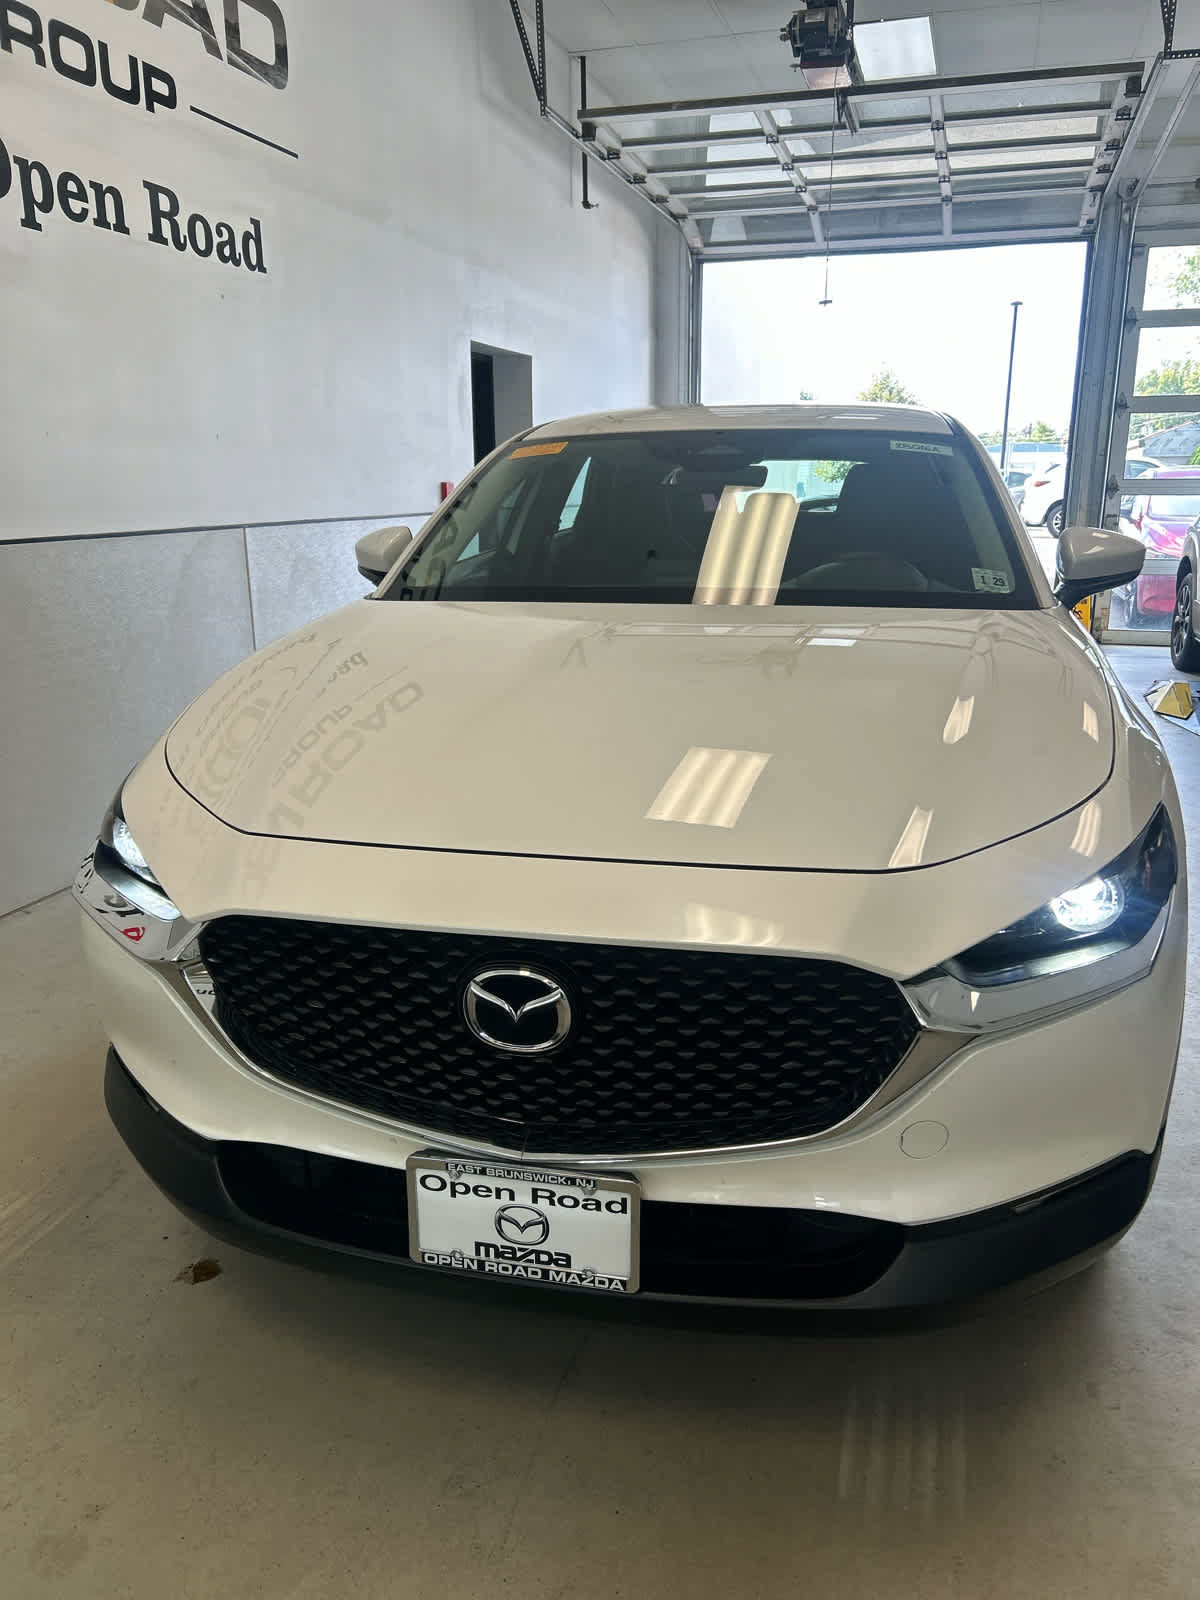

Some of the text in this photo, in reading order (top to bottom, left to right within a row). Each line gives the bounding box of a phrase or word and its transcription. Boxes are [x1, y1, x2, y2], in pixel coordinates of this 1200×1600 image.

[0, 137, 268, 274] pen Road
[992, 576, 1006, 586] 29
[419, 1174, 628, 1215] Open Road
[447, 1162, 596, 1189] EAST BRUNSWICK, NJ
[424, 1252, 625, 1292] OPEN ROAD MAZDA
